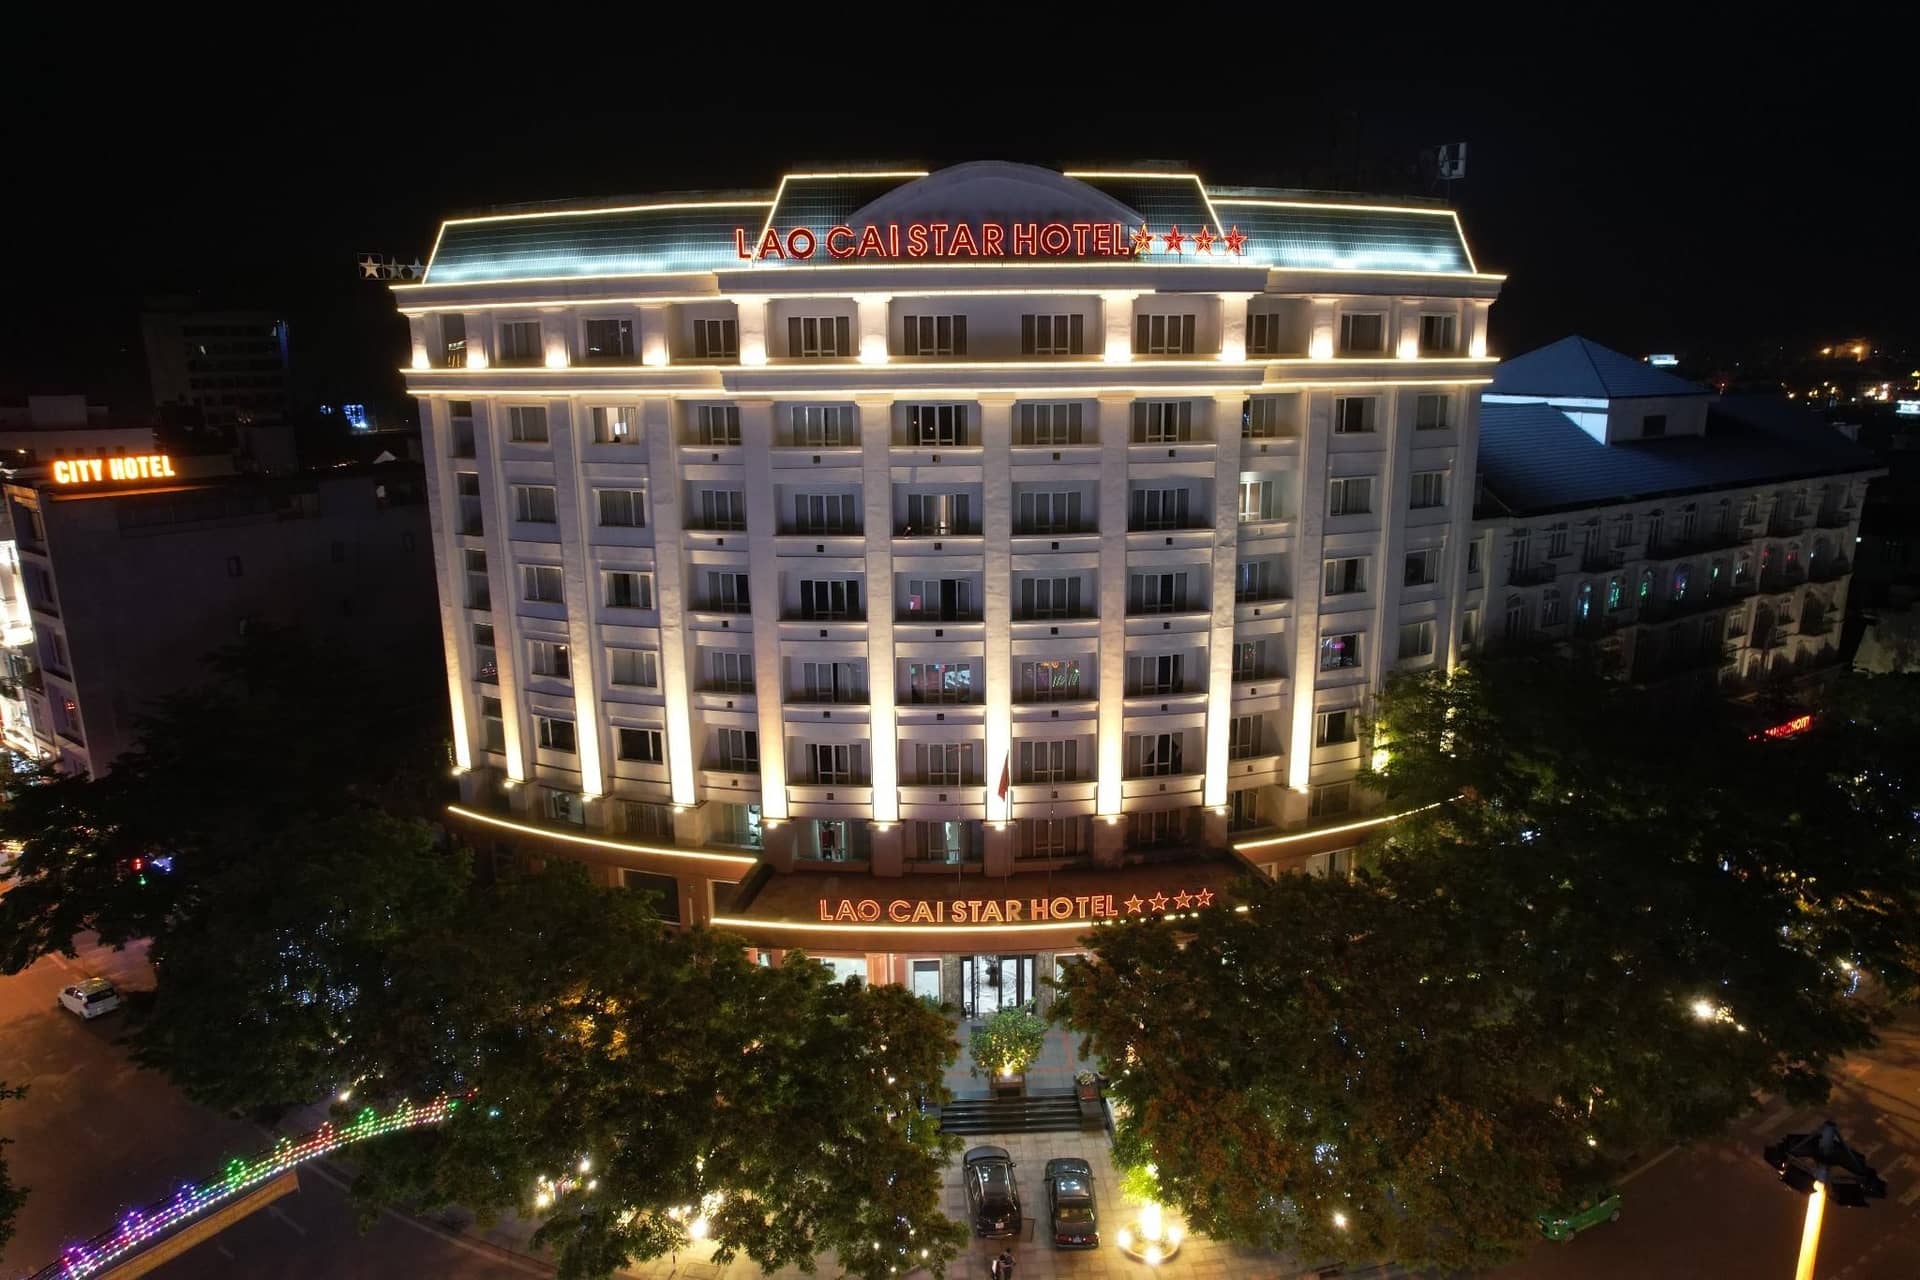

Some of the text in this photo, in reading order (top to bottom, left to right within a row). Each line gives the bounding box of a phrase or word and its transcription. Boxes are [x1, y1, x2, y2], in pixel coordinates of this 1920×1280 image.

[735, 222, 1131, 260] LAO CAI STAR HOTEL
[53, 455, 176, 484] CITY HOTEL
[819, 894, 1119, 923] LAO CAI STAR HOTEL
